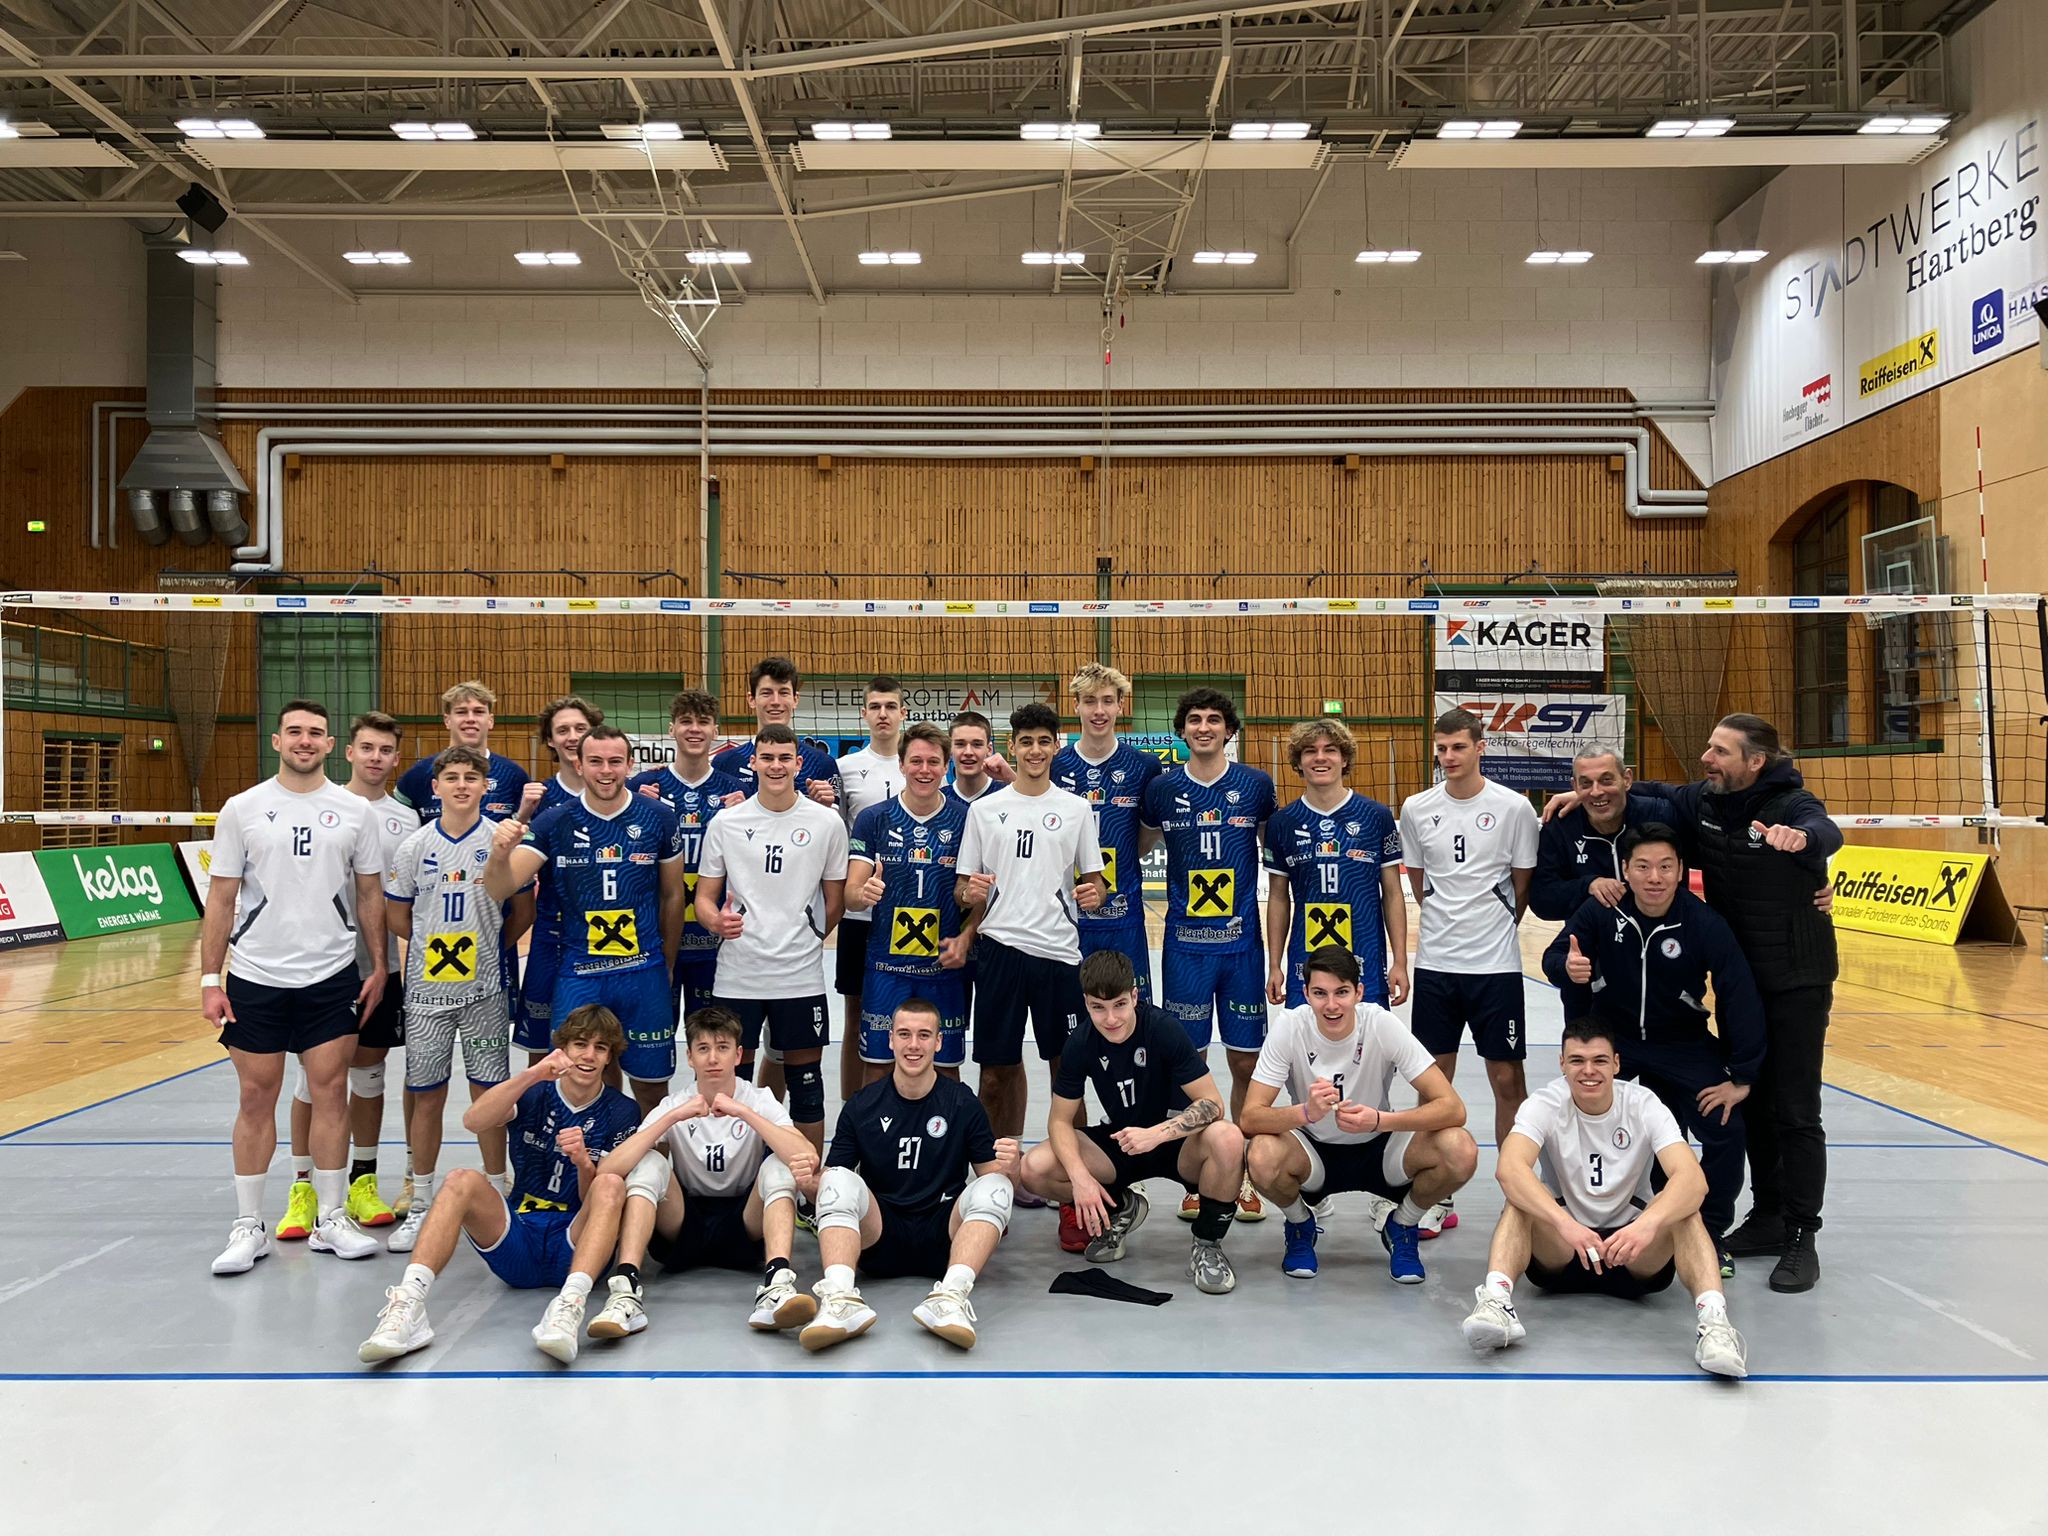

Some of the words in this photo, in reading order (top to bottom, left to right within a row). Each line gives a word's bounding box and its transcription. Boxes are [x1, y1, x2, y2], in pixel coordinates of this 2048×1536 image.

[1785, 120, 2039, 320] STADTWERKE
[1906, 197, 2040, 294] Hartberg
[1973, 323, 2002, 346] UNIQA
[1860, 356, 1918, 396] Raiffeisen
[1477, 621, 1592, 647] KAGER
[821, 688, 1000, 711] ELEROTEAM
[293, 826, 312, 856] 12
[682, 833, 701, 864] 17
[1016, 829, 1034, 859] 10
[1200, 831, 1221, 860] 41
[1453, 834, 1465, 863] 9
[765, 844, 783, 873] 16
[1576, 854, 1589, 864] AP
[73, 853, 164, 905] kelag
[603, 869, 617, 900] 6
[916, 869, 924, 899] 1
[1318, 863, 1339, 894] 19
[1833, 870, 1930, 908] Raiffeisen
[97, 914, 131, 929] ENERGIE
[129, 914, 136, 924] &
[135, 909, 162, 922] WÄRME
[442, 892, 464, 922] 10
[1863, 908, 1900, 925] Förderer
[1900, 913, 1918, 927] des
[1917, 914, 1951, 933] Sports
[1177, 926, 1240, 941] Hartberg
[812, 1006, 822, 1022] 16
[1067, 1013, 1077, 1029] 10
[1509, 1019, 1516, 1035] 9
[1116, 1078, 1135, 1108] 17
[706, 1144, 725, 1172] 18
[898, 1136, 922, 1170] 27
[1589, 1153, 1604, 1187] 3
